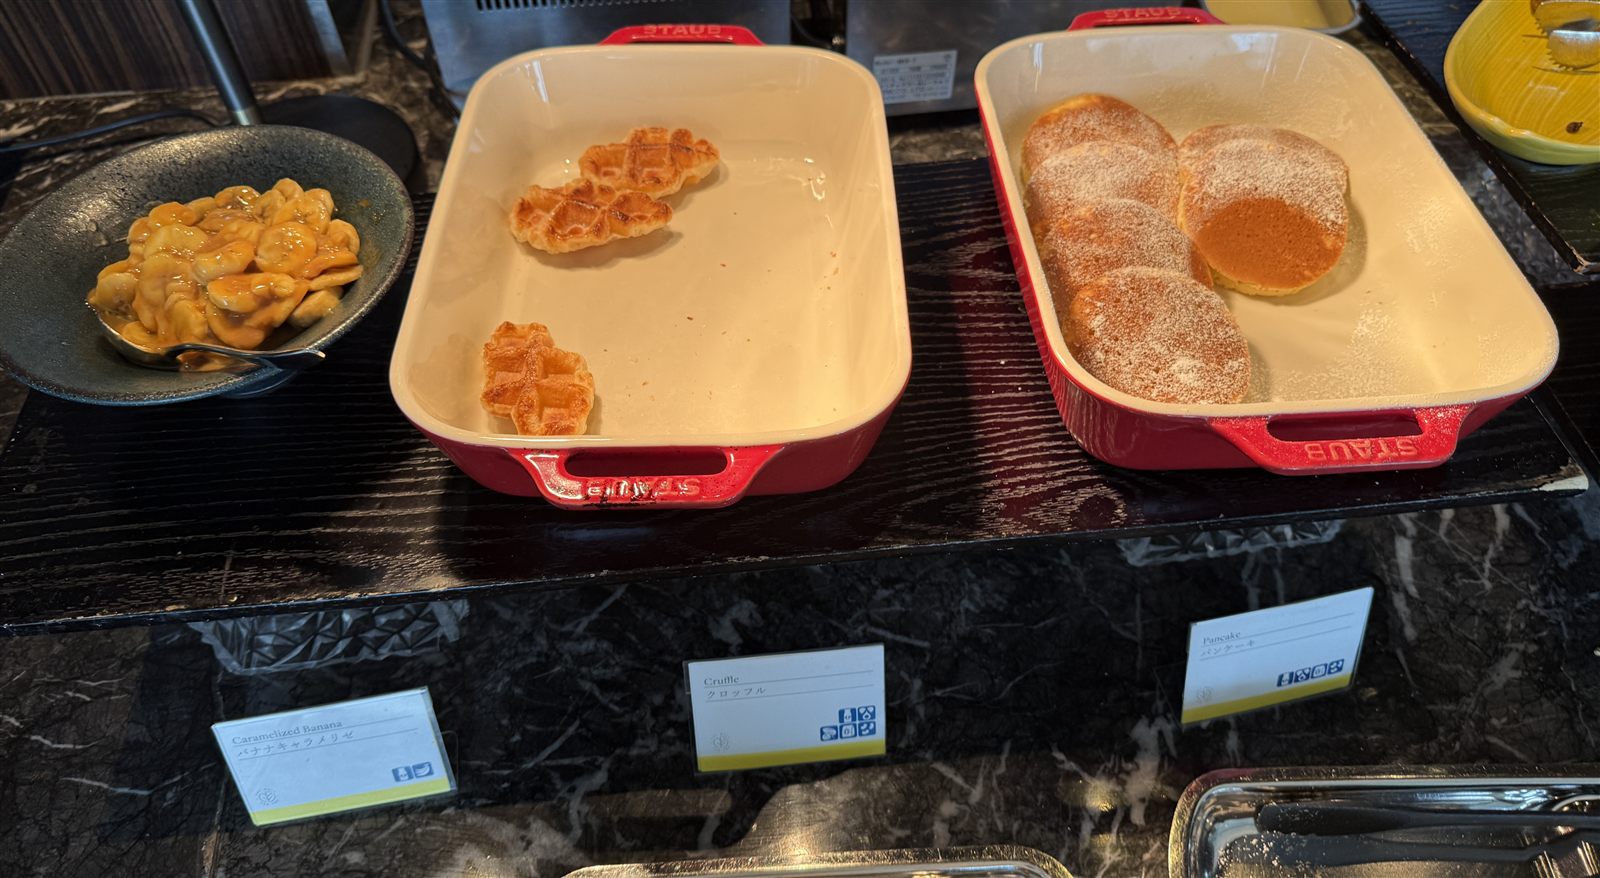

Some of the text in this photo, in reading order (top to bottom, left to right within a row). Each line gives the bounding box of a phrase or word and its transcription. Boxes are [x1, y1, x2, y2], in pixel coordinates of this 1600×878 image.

[1103, 6, 1181, 19] STAUB
[642, 23, 722, 36] STAUB
[1303, 438, 1419, 461] STAUB
[1202, 631, 1242, 646] Pancake
[231, 719, 344, 746] Caramelized Banana
